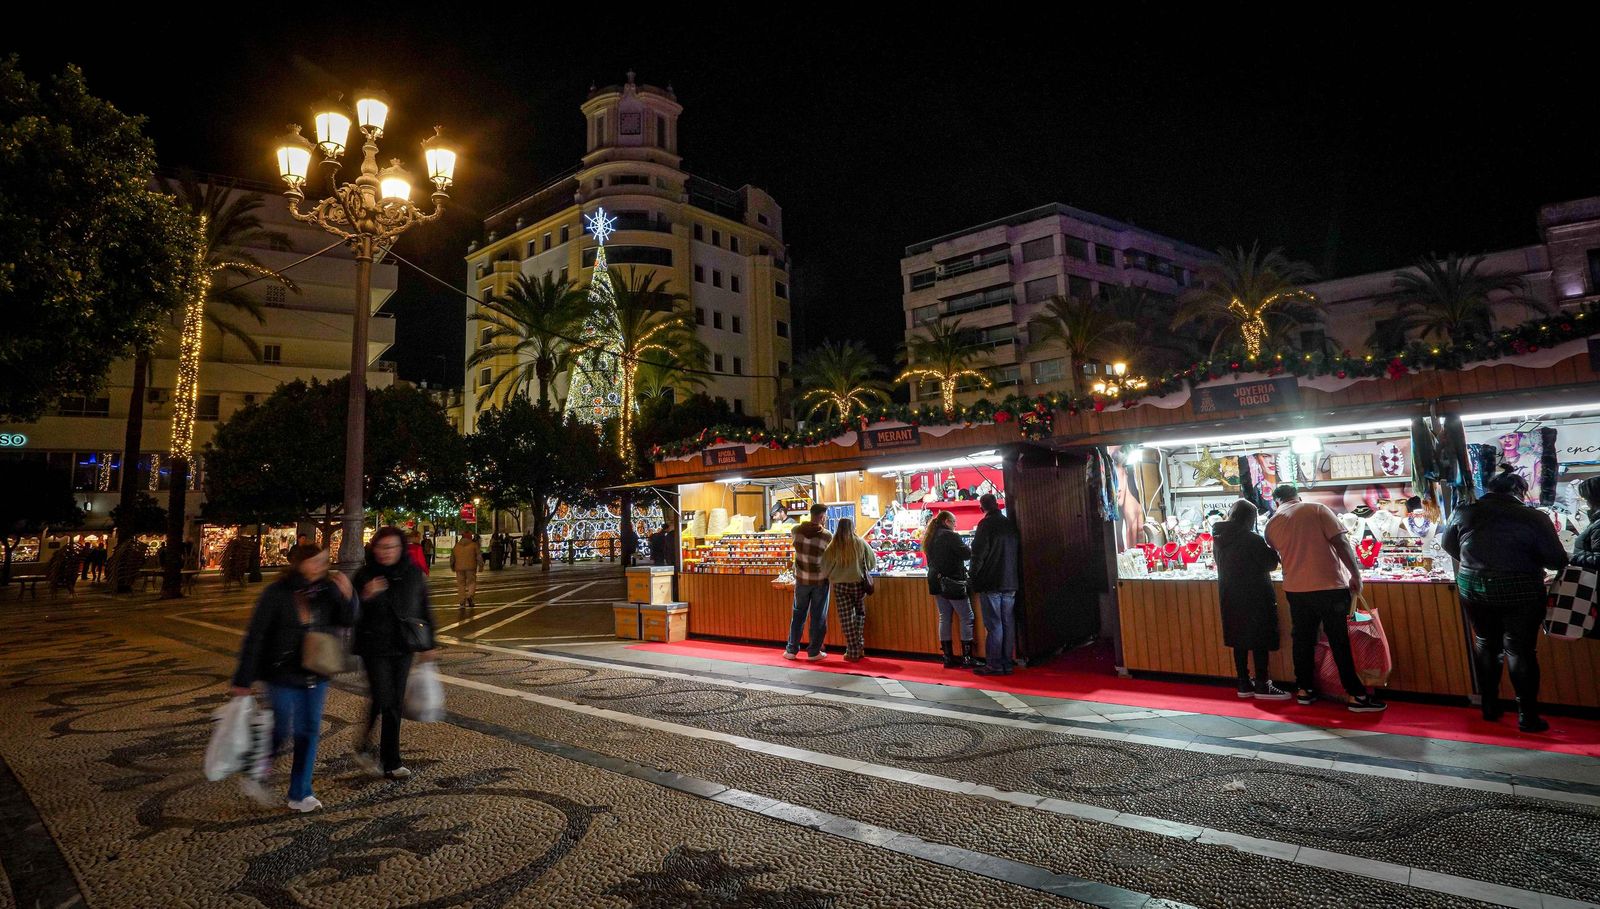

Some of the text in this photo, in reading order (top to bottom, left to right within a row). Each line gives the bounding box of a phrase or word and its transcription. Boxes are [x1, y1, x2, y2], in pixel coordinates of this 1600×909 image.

[1233, 383, 1276, 398] JOYERIA
[1240, 393, 1270, 407] ROCIO
[877, 429, 913, 442] MERANT
